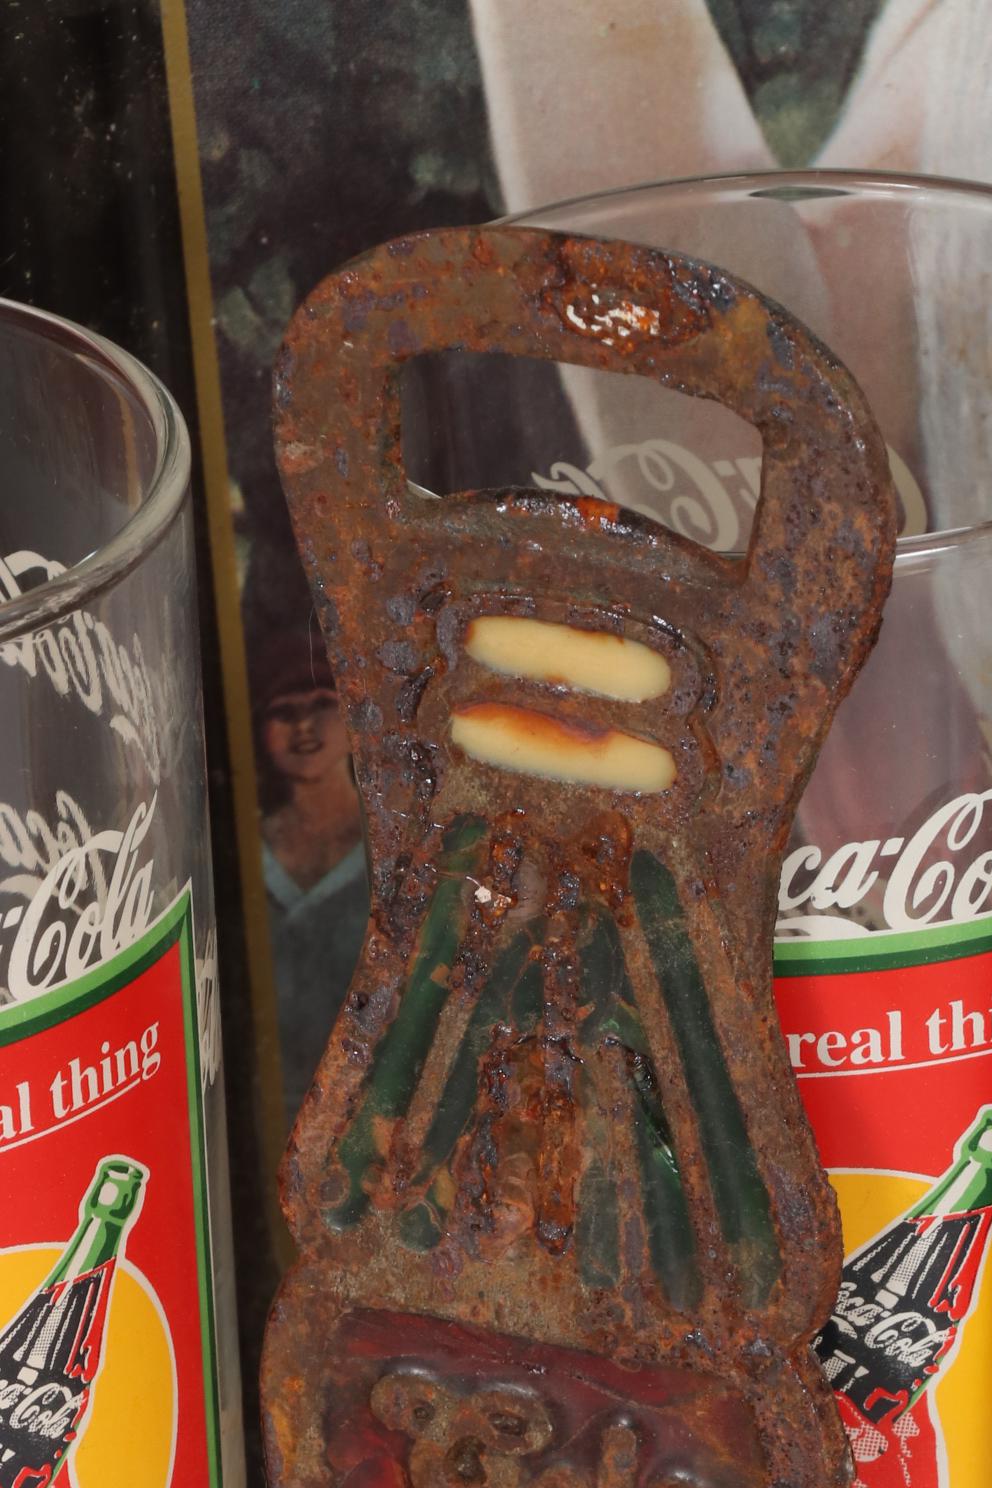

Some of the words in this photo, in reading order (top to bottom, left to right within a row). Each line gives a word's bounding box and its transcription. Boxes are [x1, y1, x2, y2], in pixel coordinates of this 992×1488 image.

[0, 789, 158, 1003] -Cola
[0, 1080, 35, 1140] al
[49, 1020, 162, 1120] thing
[786, 1010, 906, 1069] real
